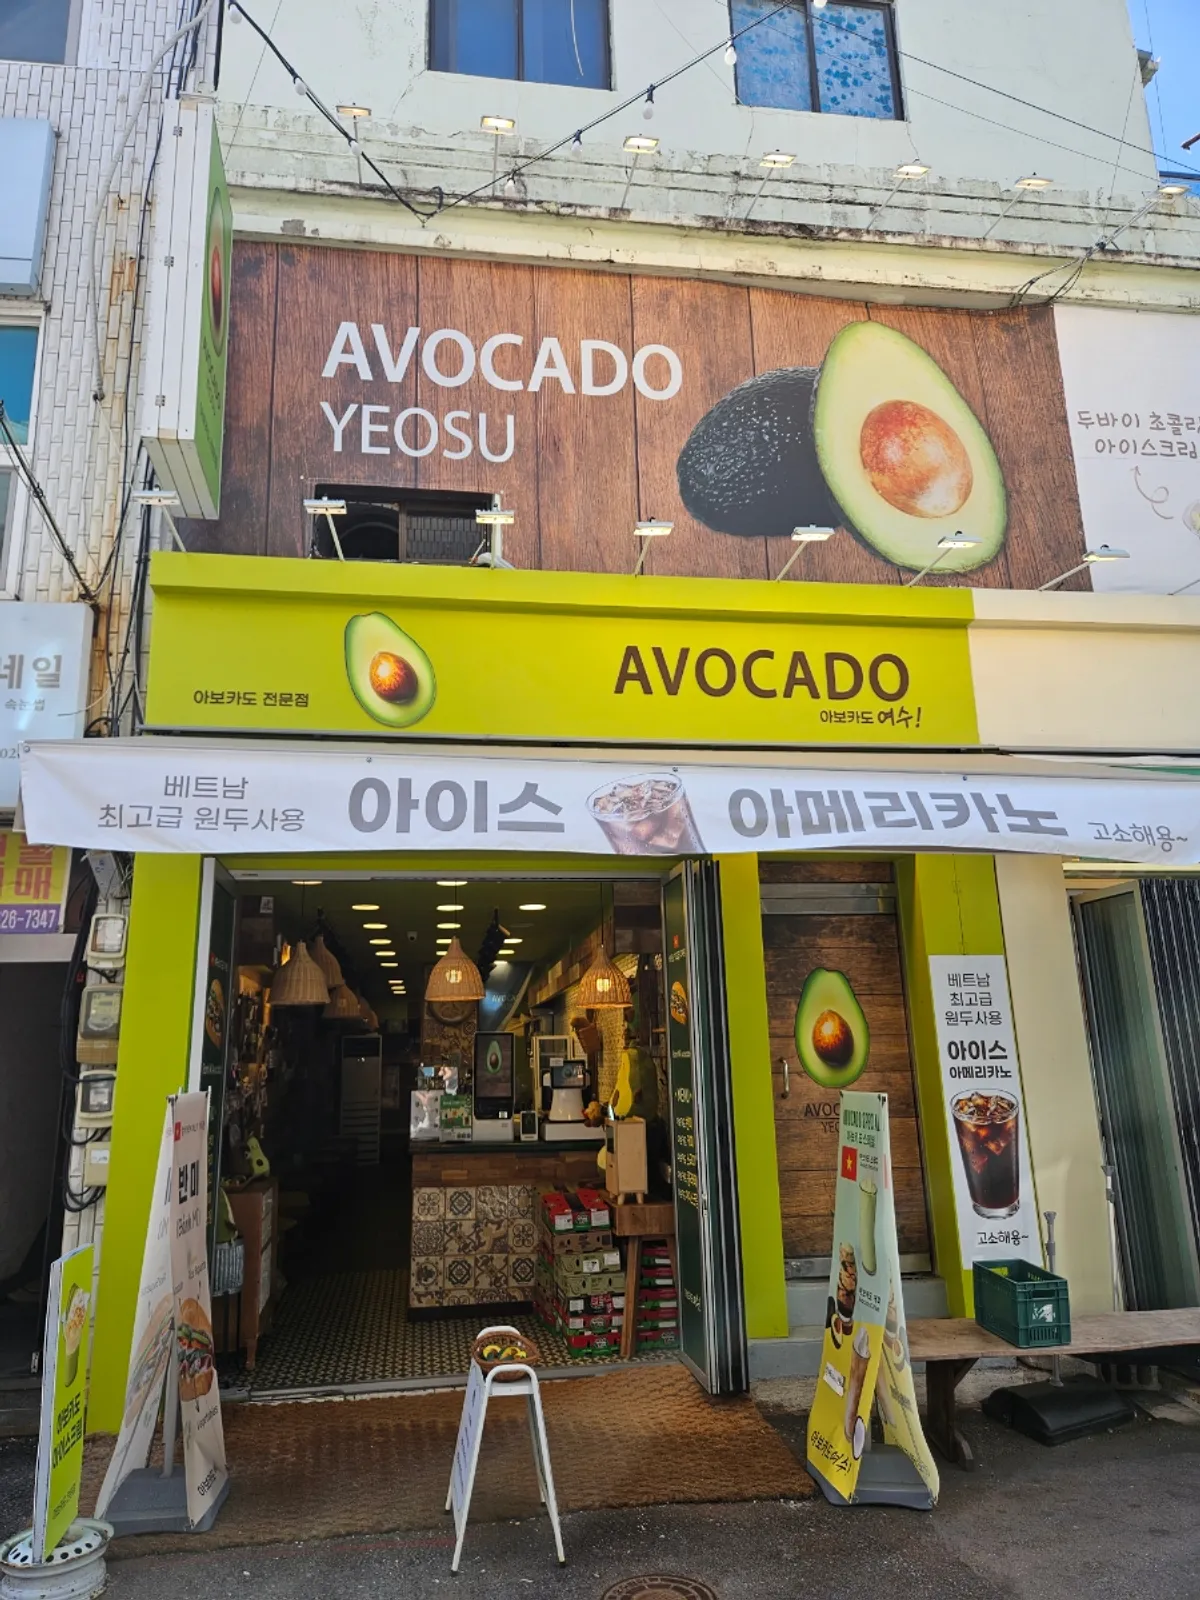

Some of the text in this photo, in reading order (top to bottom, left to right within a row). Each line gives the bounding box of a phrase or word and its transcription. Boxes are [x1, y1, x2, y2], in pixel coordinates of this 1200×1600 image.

[321, 321, 683, 401] AVOCADO
[1077, 410, 1140, 429] 두바이
[320, 401, 515, 463] YEOSU
[1094, 438, 1198, 459] 아이스크림
[613, 644, 910, 703] AVOCADO
[193, 688, 310, 709] 아보카도 전문점
[819, 706, 922, 729] 아보카도 여수!
[163, 774, 249, 800] 베트남
[347, 776, 1068, 839] 아이스 아메리카노
[98, 804, 306, 833] 최고급 원두사용
[1093, 819, 1188, 853] 고소해용~
[0, 908, 57, 929] 26-7347
[947, 972, 990, 988] 베트남
[950, 991, 993, 1007] 최고급
[945, 1010, 1002, 1027] 원두사용
[947, 1040, 1008, 1061] 아이스
[950, 1065, 1012, 1079] 아메리카노
[803, 1102, 840, 1116] AVOC
[178, 1159, 200, 1205] 반미
[976, 1231, 1029, 1247] 고소해용~
